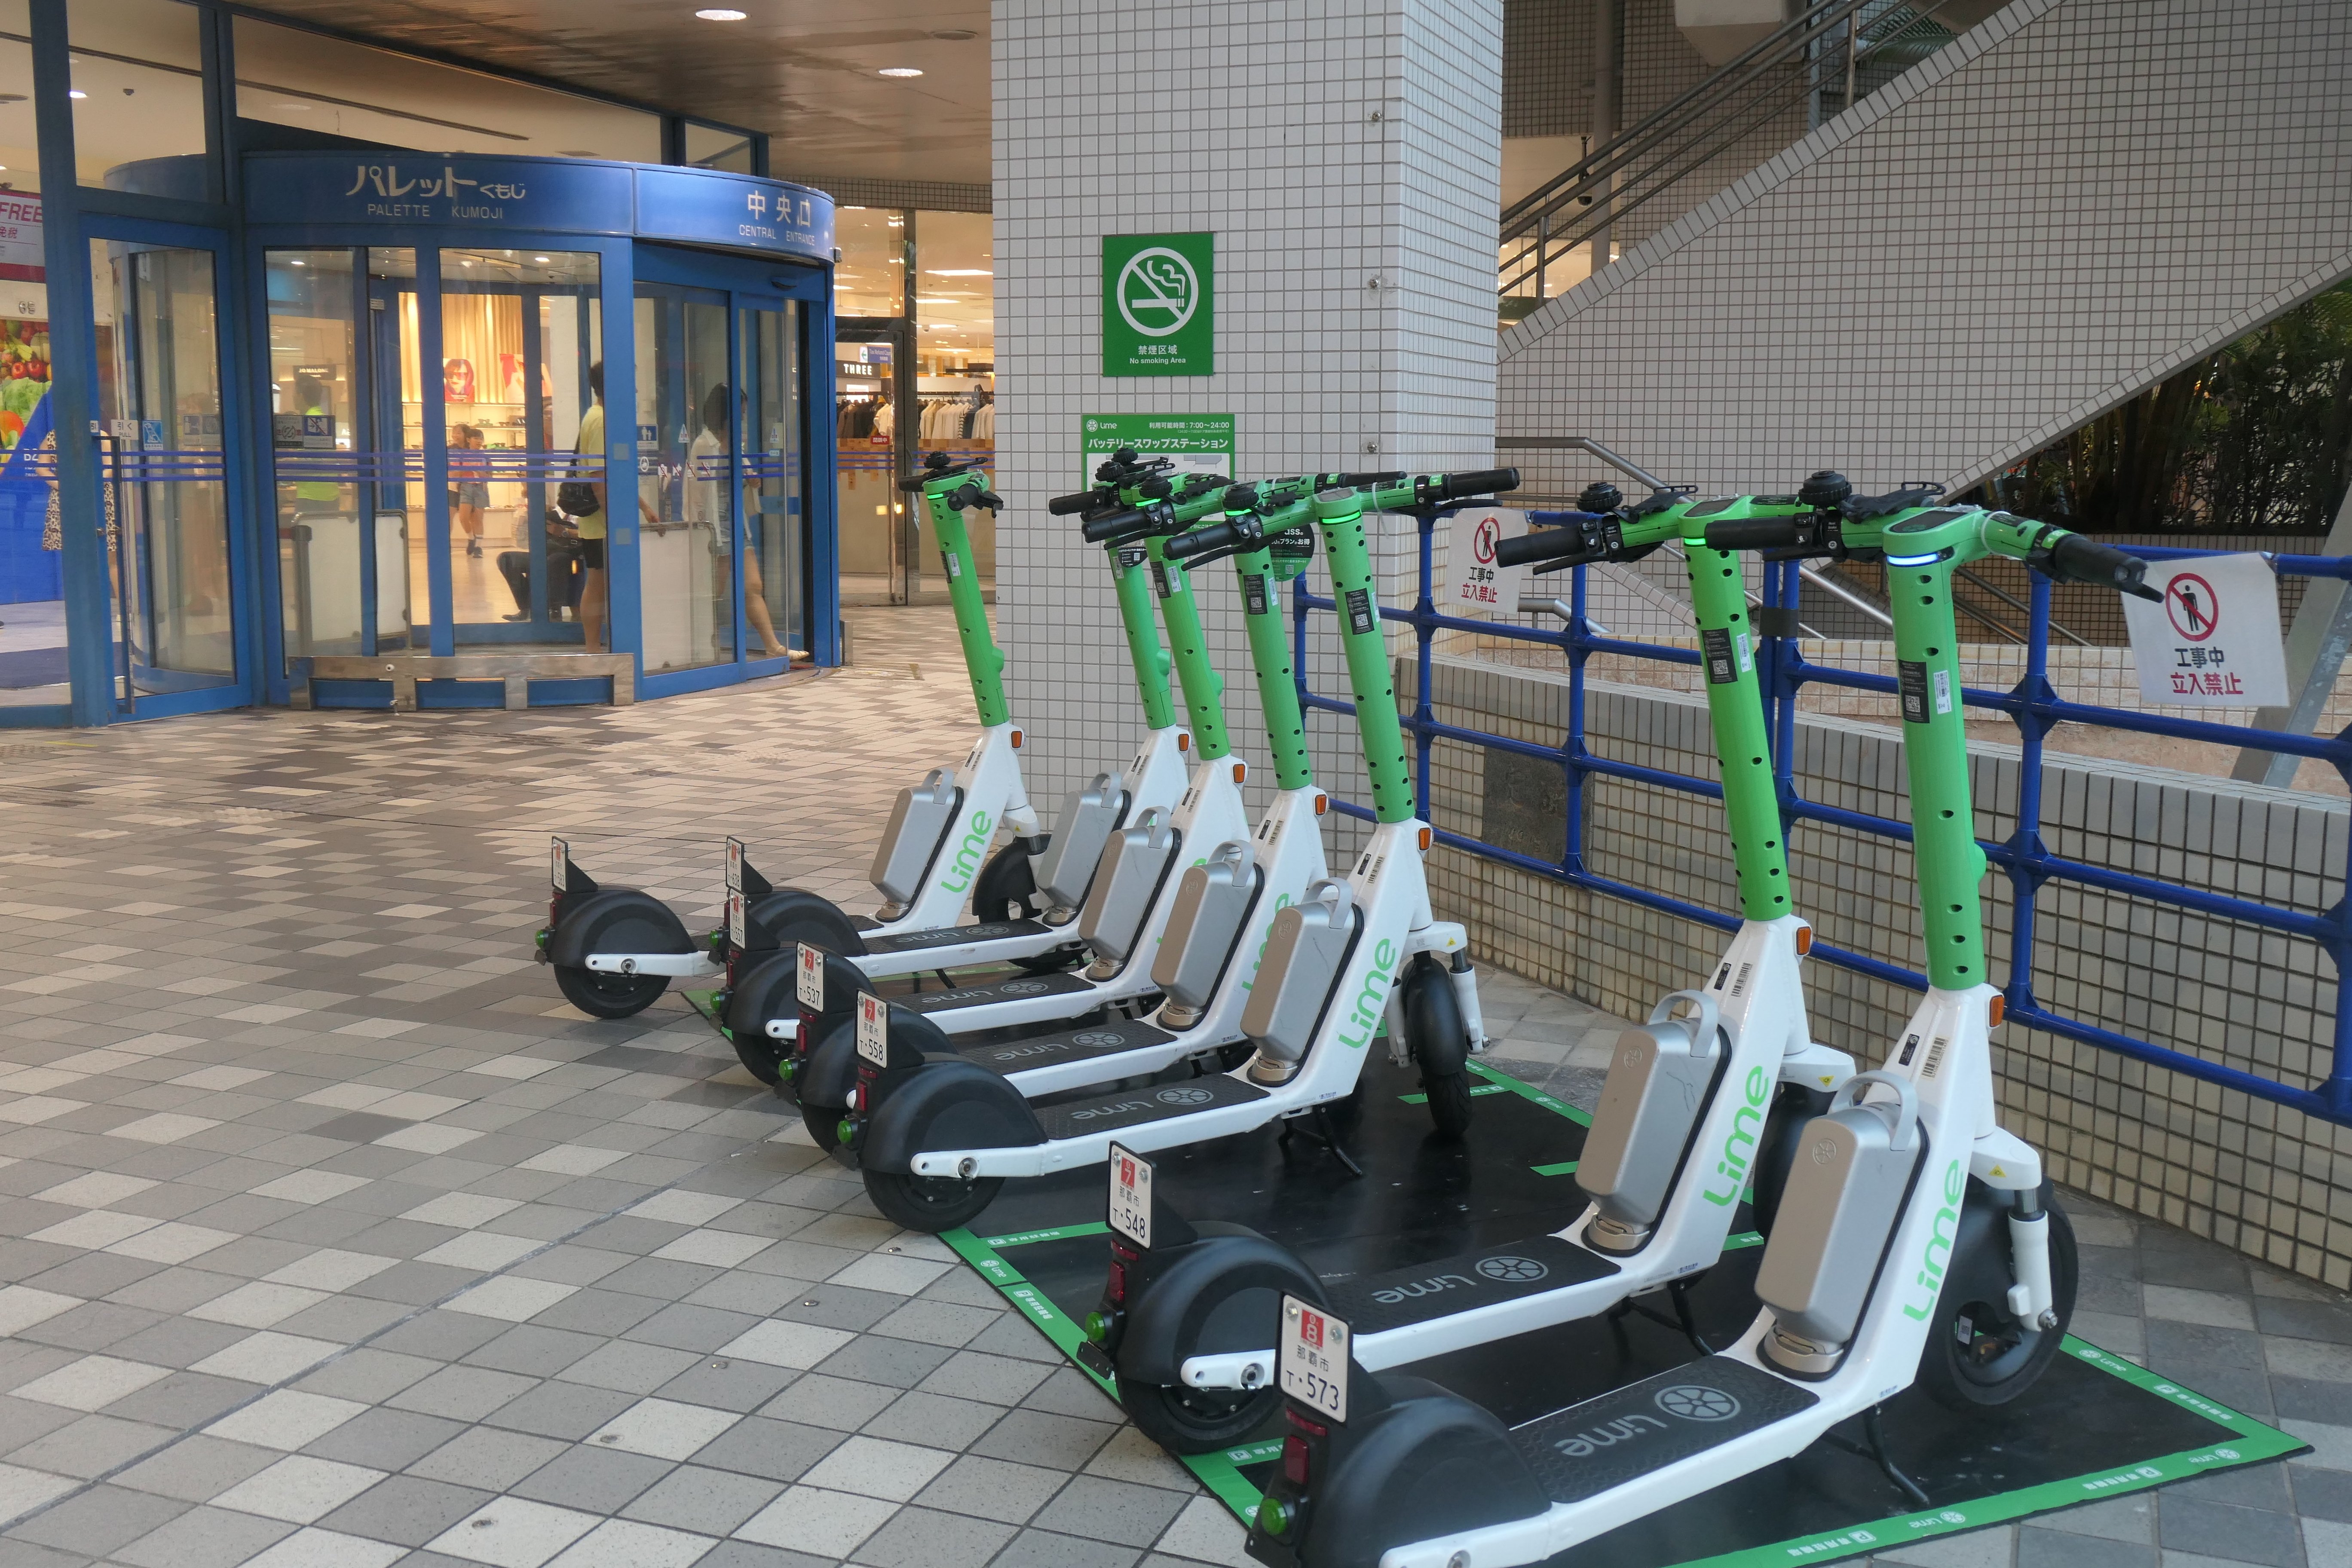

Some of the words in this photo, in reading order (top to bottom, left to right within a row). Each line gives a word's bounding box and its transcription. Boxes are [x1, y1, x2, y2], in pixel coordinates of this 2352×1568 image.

[368, 204, 430, 217] PALETTE
[452, 206, 503, 219] KUMOJI
[747, 190, 811, 227] 中央口
[739, 224, 776, 240] CENTRAL
[786, 233, 815, 246] ENTRANCE
[1138, 345, 1178, 355] 禁煙区域
[843, 364, 872, 375] THREE
[1088, 438, 1228, 449] バッテリースワップステーション
[1469, 566, 1494, 584] 工事中
[1461, 582, 1498, 604] 立入禁止
[2174, 646, 2225, 668] 工事中
[2170, 672, 2244, 696] 立入禁止
[941, 810, 991, 893] Lime
[896, 931, 960, 943] Lime
[922, 990, 994, 1004] Lime
[1338, 938, 1396, 1048] Lime
[993, 1044, 1069, 1060] Lime
[1070, 1101, 1153, 1119] Lime
[1703, 1066, 1769, 1207] Lime
[1119, 1185, 1139, 1207] 那覇市
[1903, 1159, 1963, 1322] Lime
[991, 1266, 1007, 1277] Lime
[1372, 1274, 1477, 1303] Lime
[1297, 1344, 1329, 1372] 那覇市
[2100, 1358, 2127, 1371] Lime
[1553, 1414, 1668, 1456] Lime
[1909, 1518, 1942, 1530] Lime
